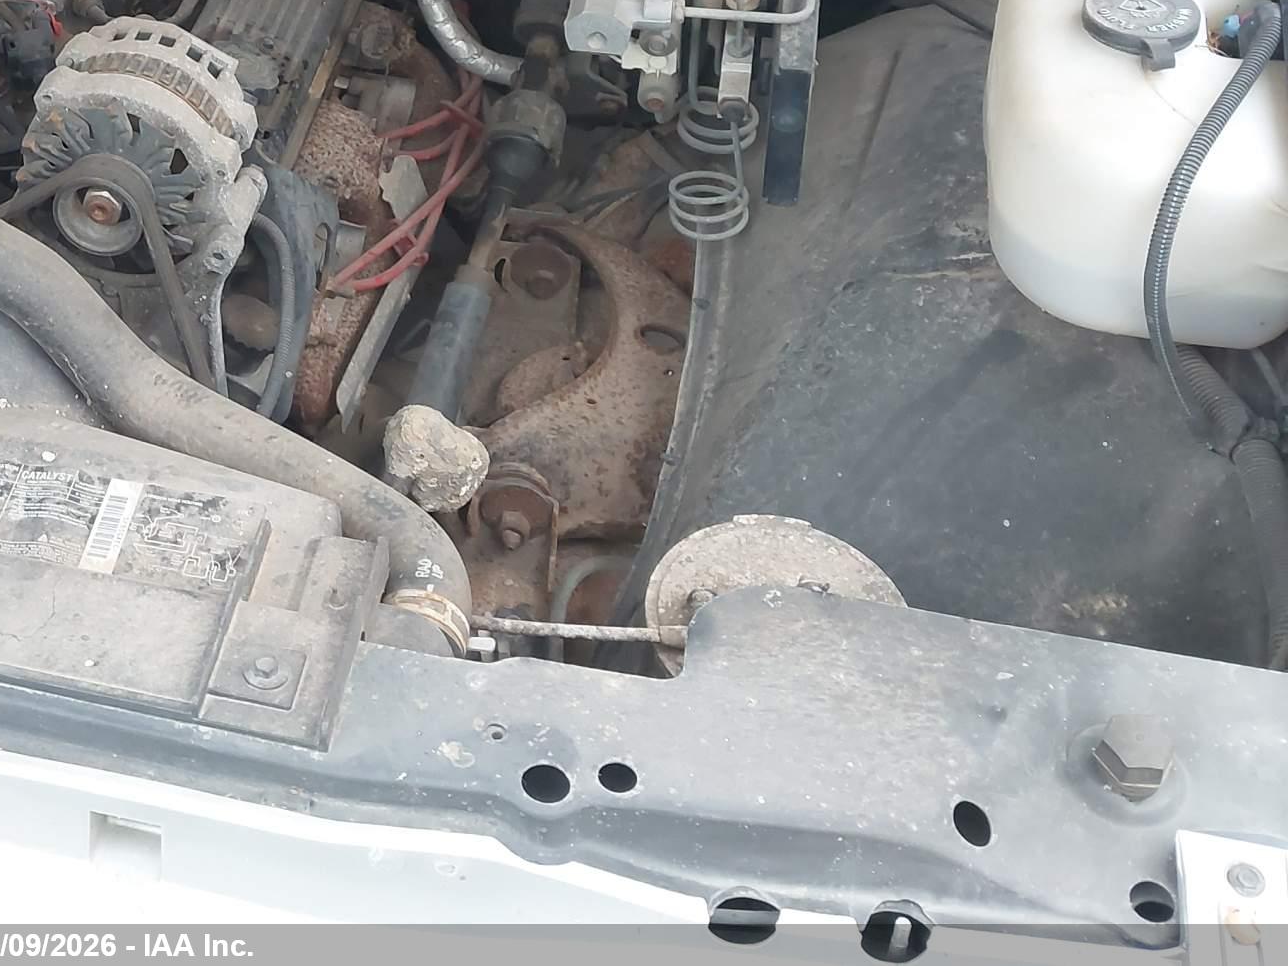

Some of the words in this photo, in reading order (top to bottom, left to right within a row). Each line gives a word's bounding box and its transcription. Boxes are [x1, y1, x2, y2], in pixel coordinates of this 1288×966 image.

[1097, 8, 1137, 31] FLUID
[1145, 7, 1194, 33] WASHER
[21, 470, 73, 483] CATALYST
[415, 558, 433, 578] RAD
